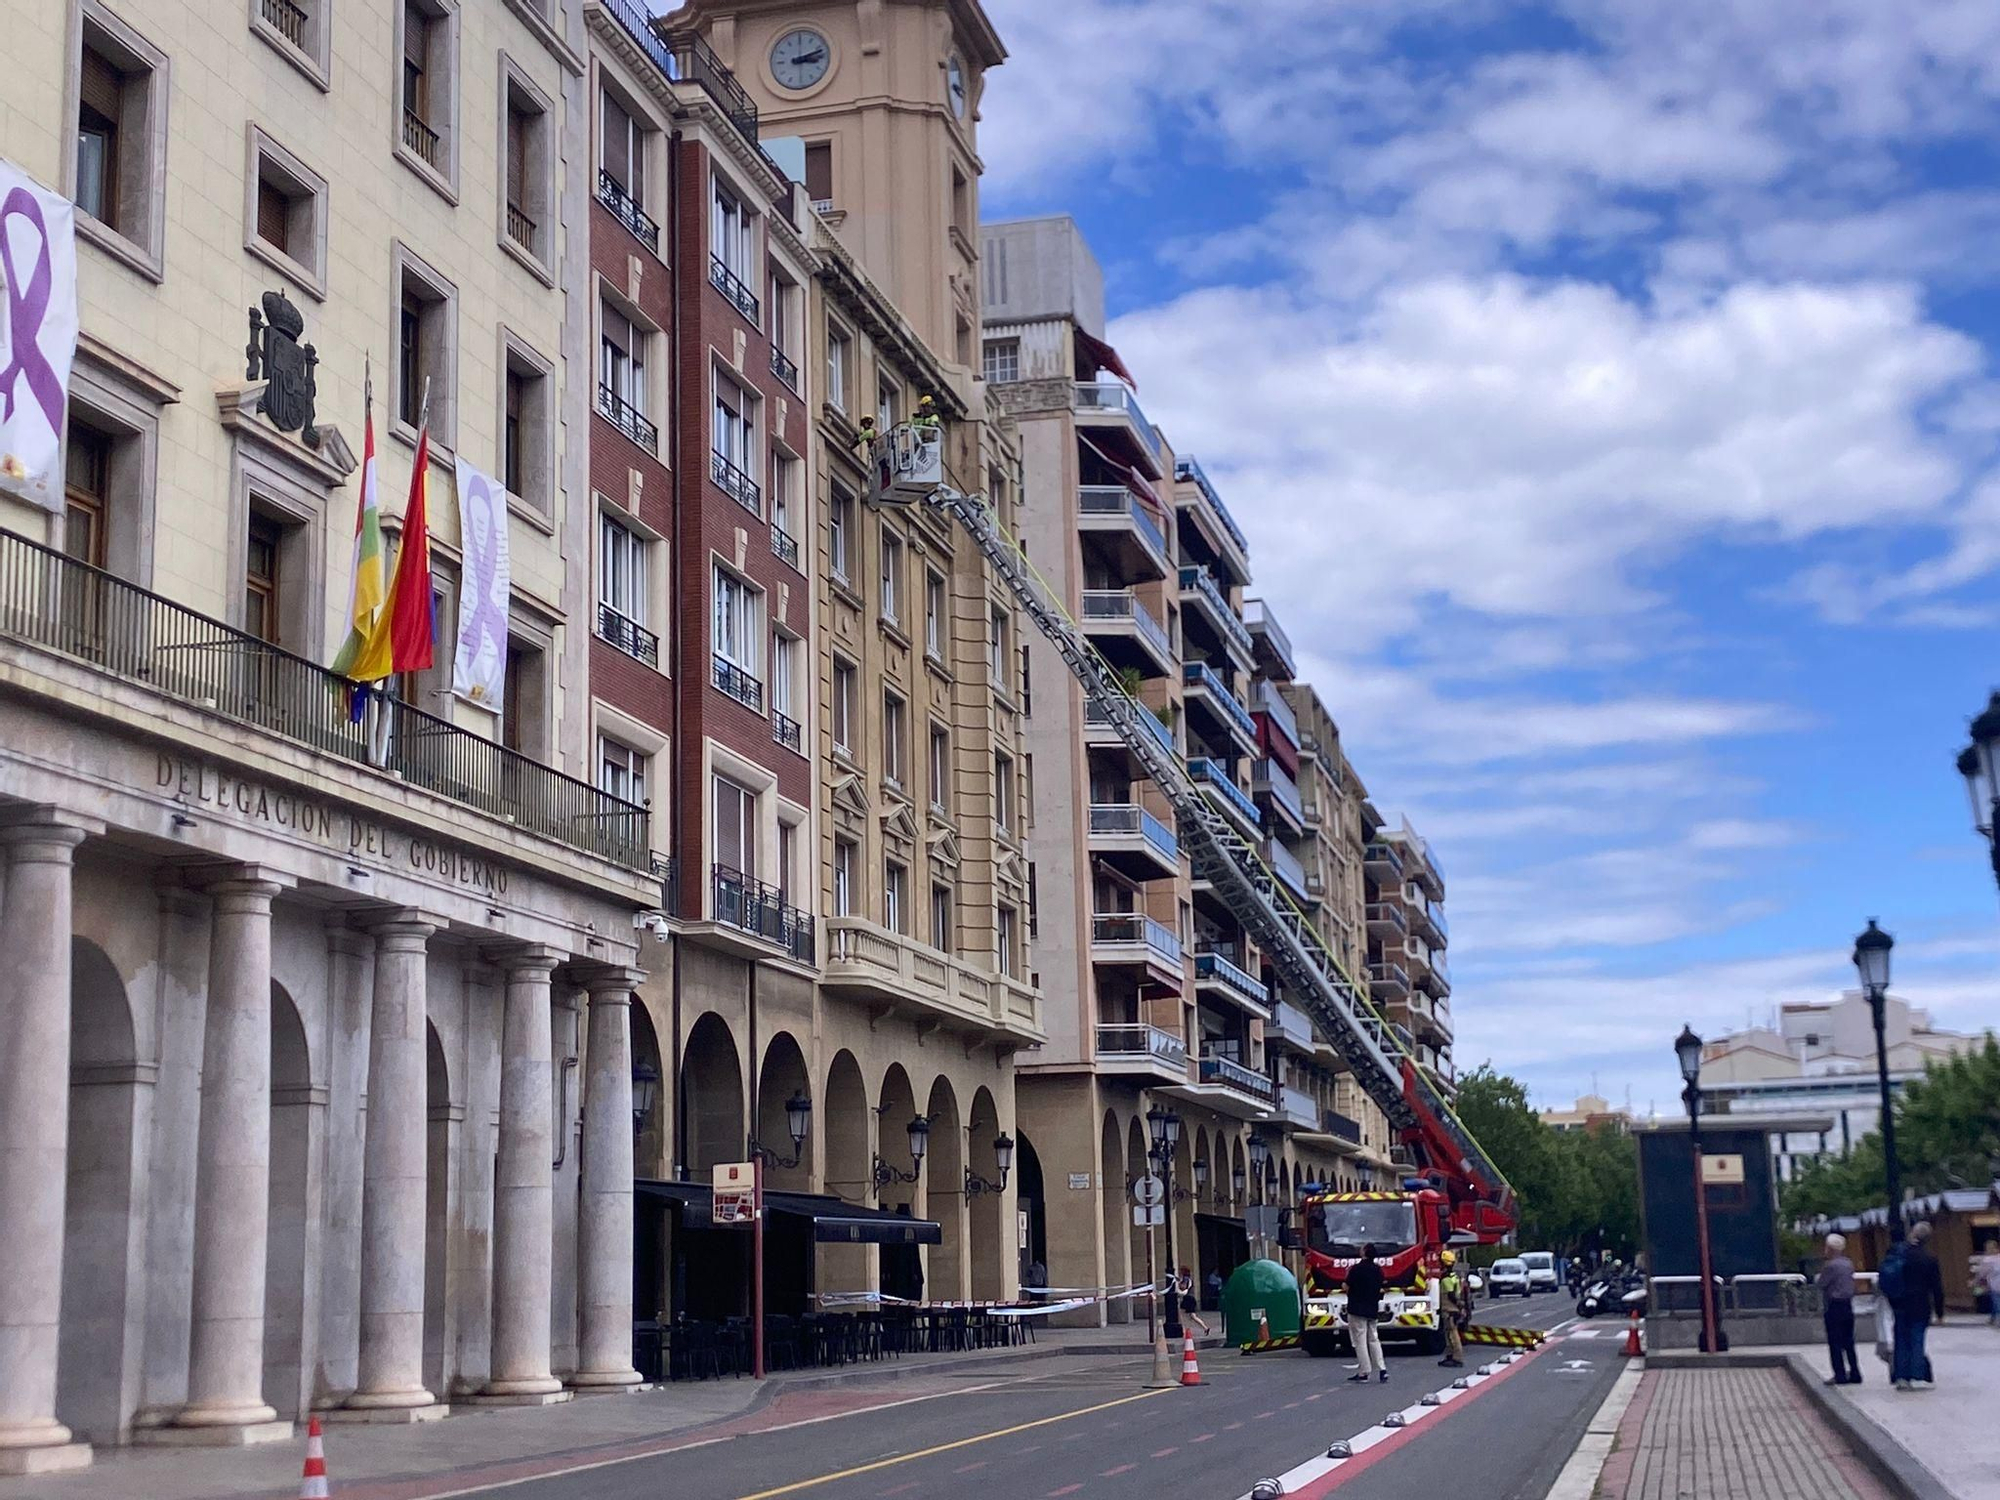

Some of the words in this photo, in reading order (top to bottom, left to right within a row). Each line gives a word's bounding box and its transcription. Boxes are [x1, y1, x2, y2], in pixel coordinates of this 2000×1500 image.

[156, 753, 331, 839] DELEGACION
[349, 815, 393, 859] DEL
[410, 839, 508, 895] GOBIERNO
